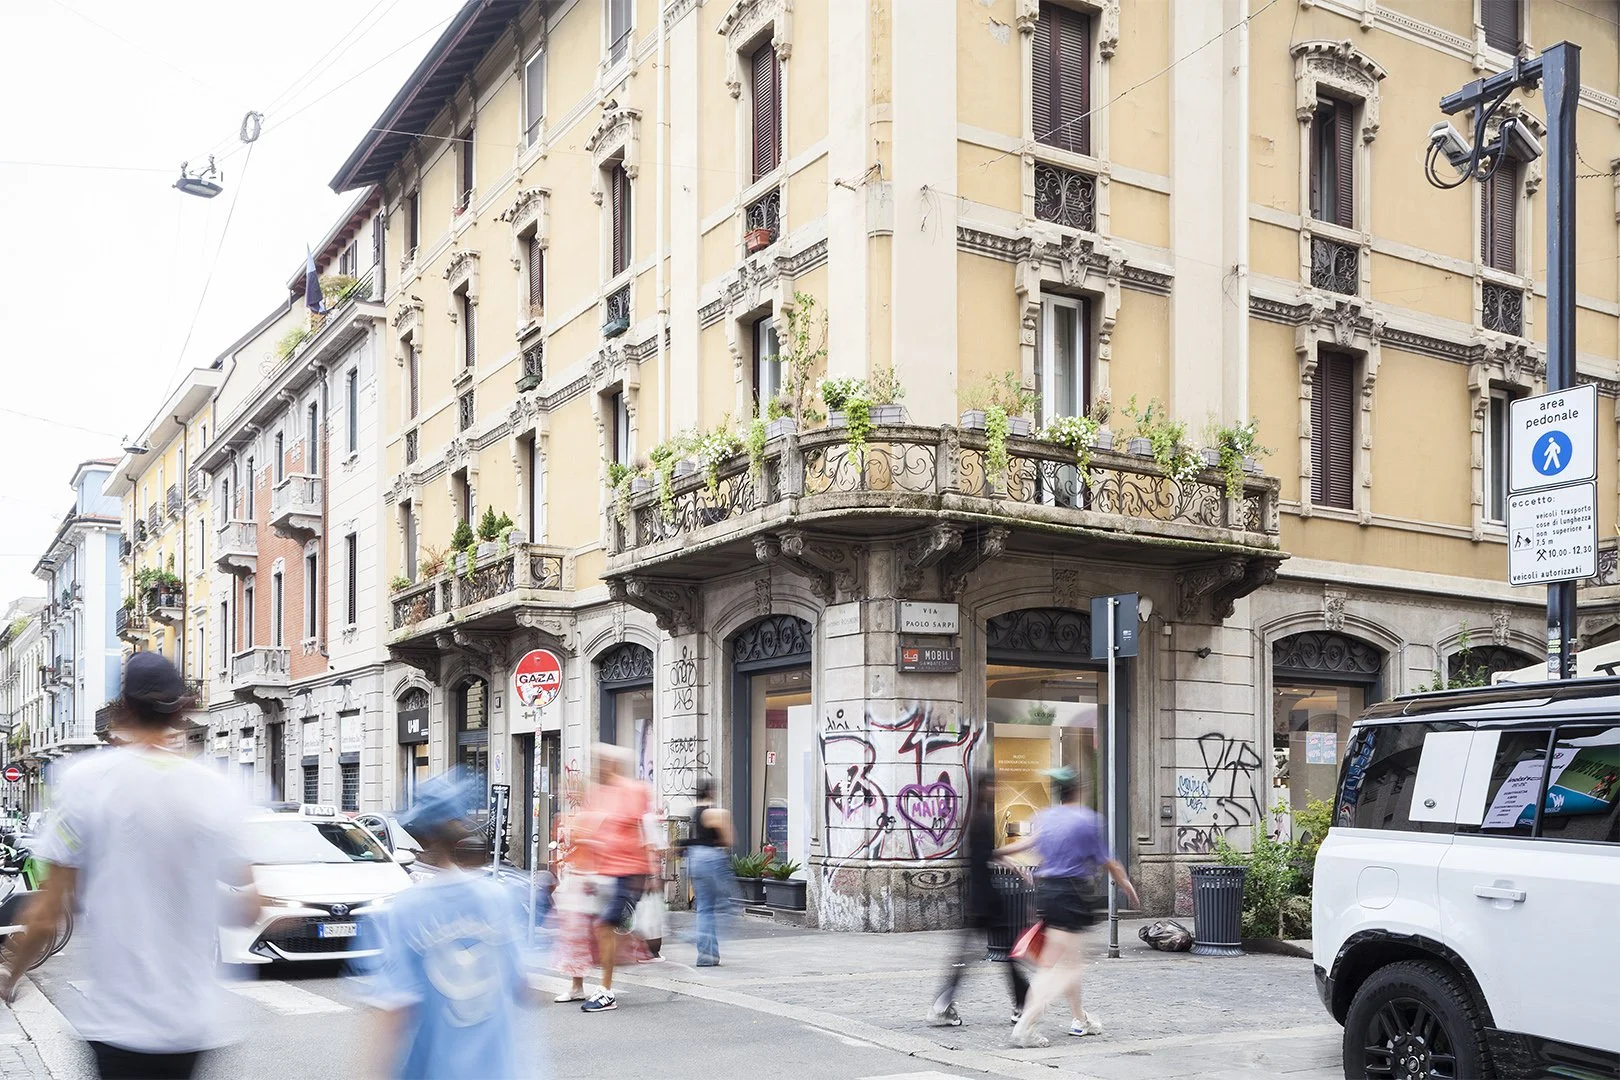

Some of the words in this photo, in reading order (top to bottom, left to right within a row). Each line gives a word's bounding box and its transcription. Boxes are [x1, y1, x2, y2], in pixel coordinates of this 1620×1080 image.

[1539, 398, 1565, 411] area
[1525, 409, 1579, 430] pedonale
[1511, 496, 1556, 508] eccetto:
[1535, 510, 1558, 519] veicoli
[1560, 505, 1592, 516] trasporto
[1535, 521, 1550, 529] cose
[1560, 515, 1592, 526] lunghezza
[1552, 525, 1582, 535] superiore
[1513, 571, 1538, 581] veicoli
[1541, 565, 1582, 578] autorizzati
[905, 620, 930, 628] PAOLO
[932, 621, 955, 629] SARPI
[924, 650, 954, 661] MOBILI
[519, 672, 556, 684] GAZA
[309, 806, 334, 816] TAXI
